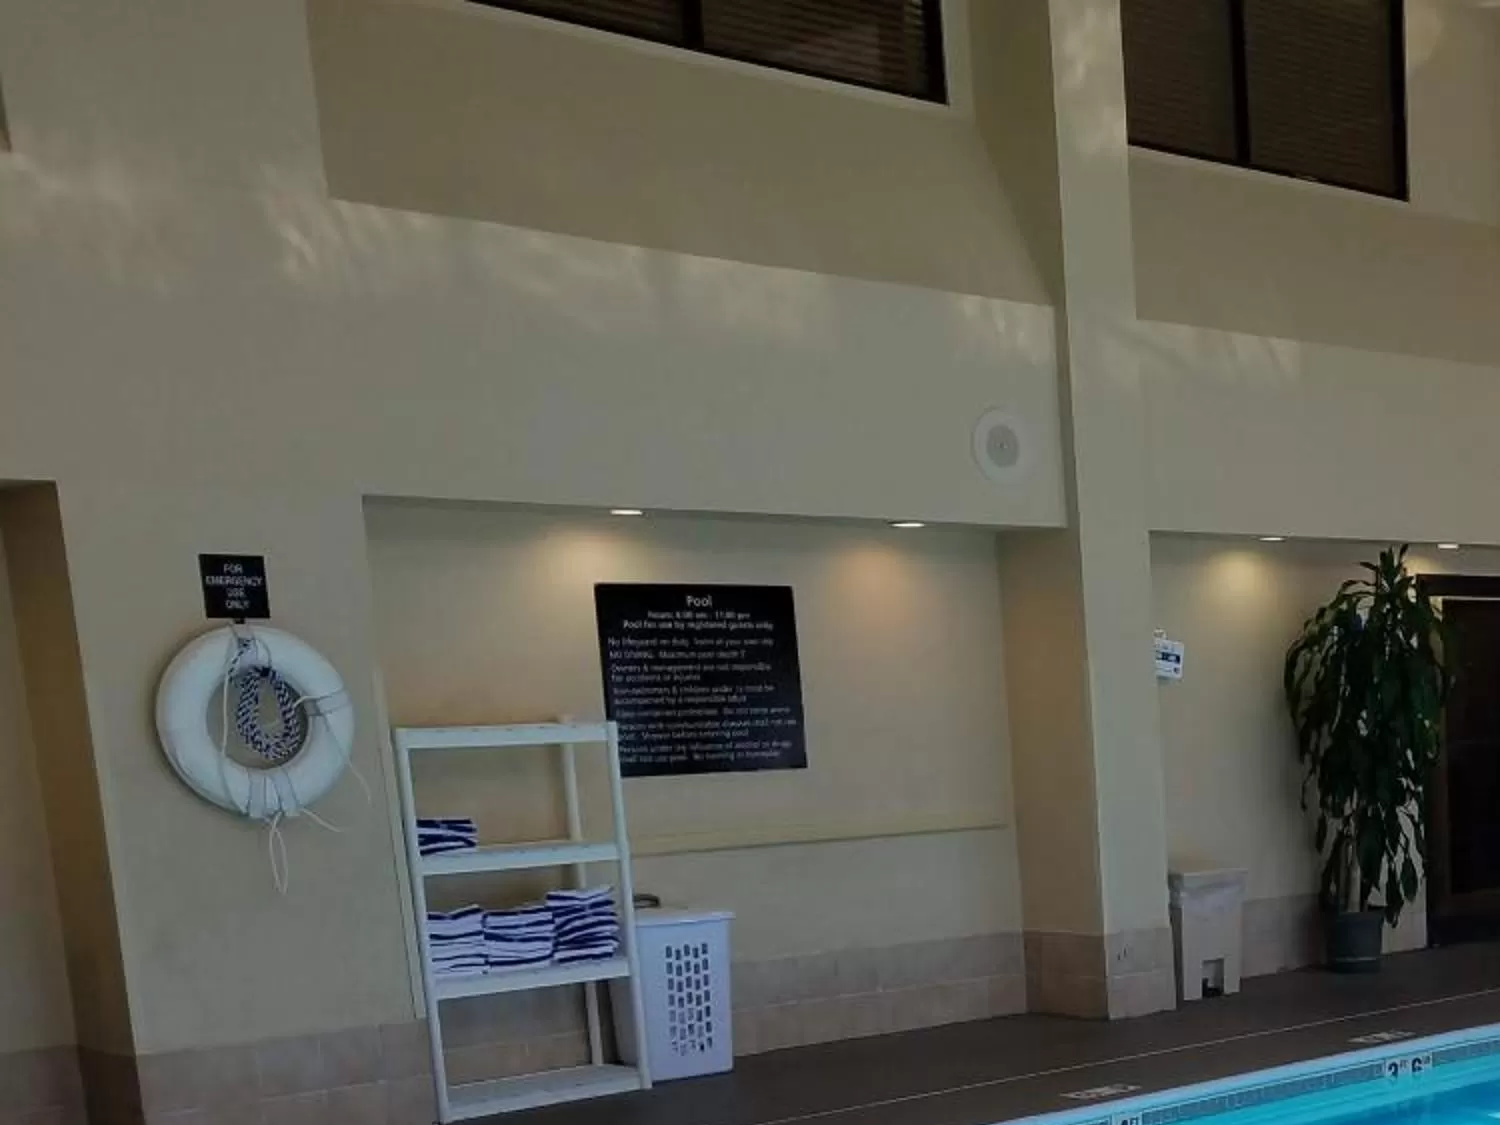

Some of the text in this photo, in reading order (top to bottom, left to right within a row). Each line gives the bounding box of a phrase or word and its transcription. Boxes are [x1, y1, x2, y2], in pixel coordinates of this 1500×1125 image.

[223, 563, 243, 574] FOR
[205, 575, 263, 586] EMERGENCY
[225, 599, 250, 610] ONLY
[685, 595, 713, 608] Pool
